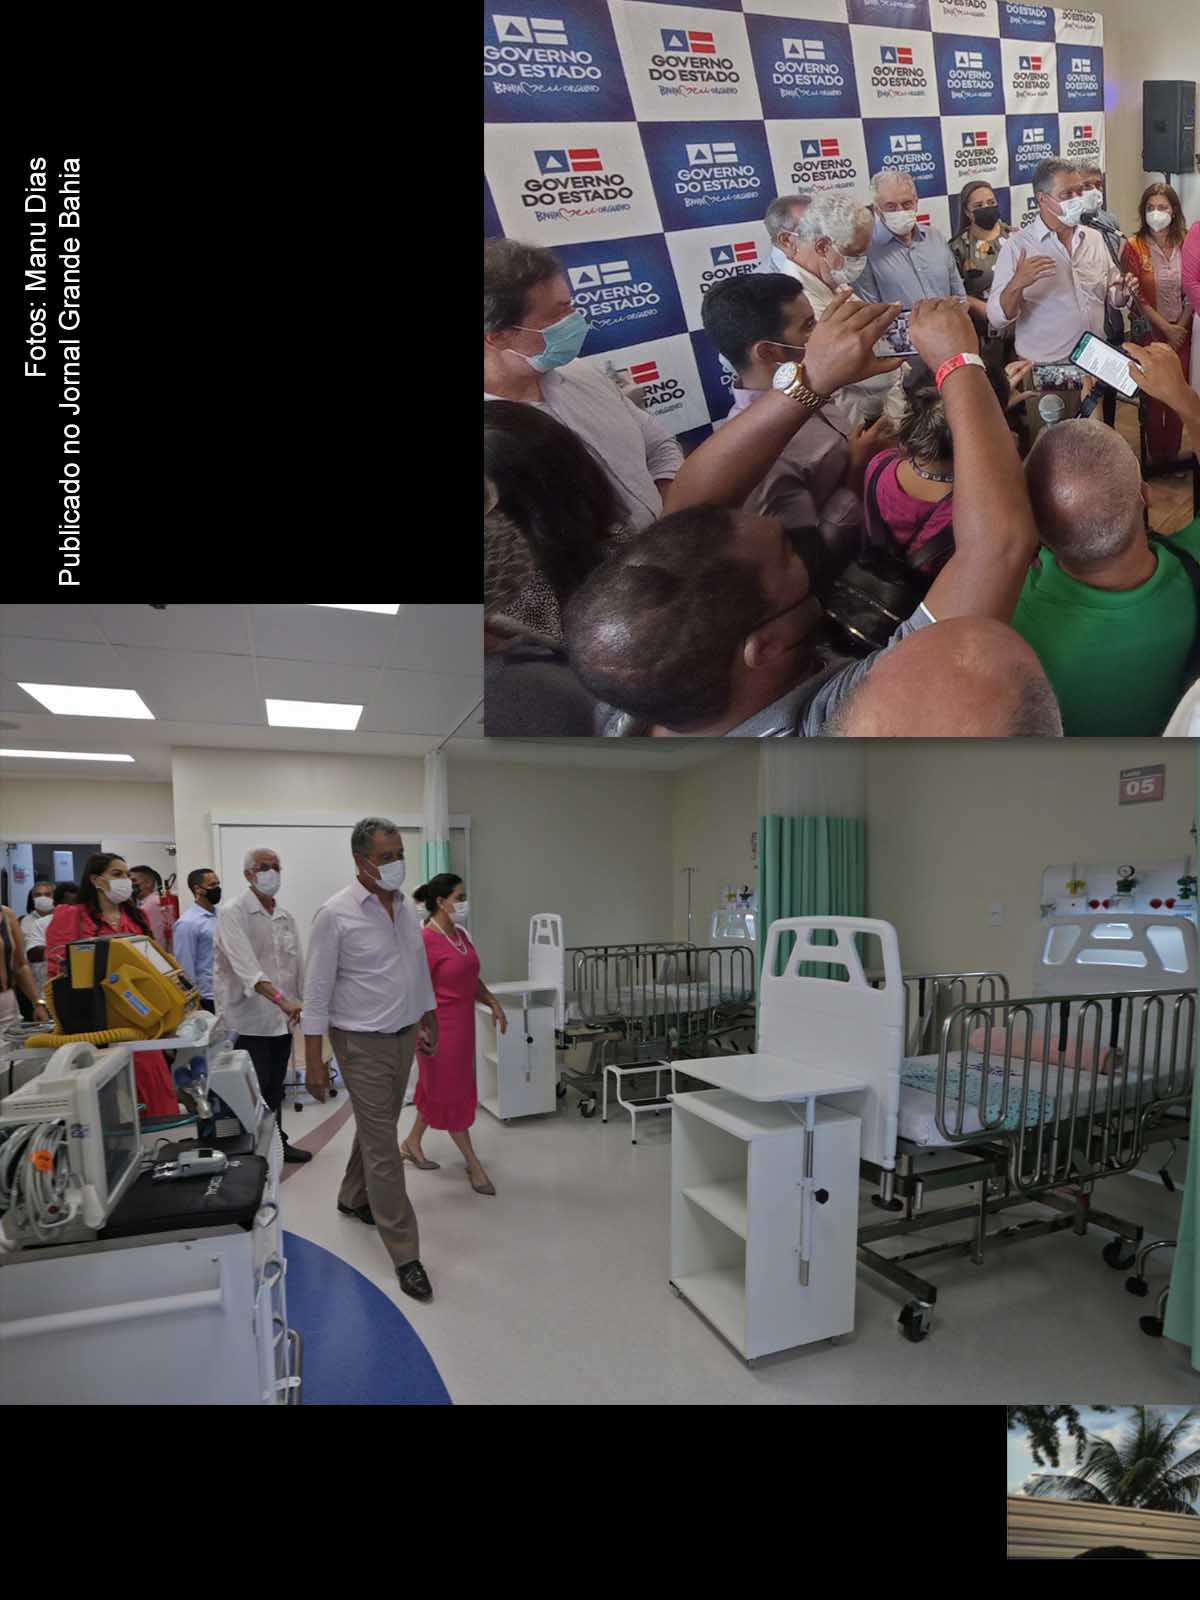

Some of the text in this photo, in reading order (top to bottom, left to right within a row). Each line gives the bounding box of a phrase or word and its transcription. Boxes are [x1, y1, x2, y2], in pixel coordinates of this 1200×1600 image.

[484, 45, 592, 64] GOVERNO
[651, 54, 734, 70] GOVERNO
[774, 61, 840, 75] GOVERNO
[519, 63, 602, 79] ESTADO
[648, 68, 740, 83] DO ESTADO
[873, 66, 924, 77] GOVERNO
[948, 69, 992, 80] GOVERNO
[1014, 72, 1048, 81] GOVERNO
[1066, 73, 1097, 82] GOVERNO
[772, 73, 844, 86] DO ESTADO
[871, 77, 927, 88] DO ESTADO
[946, 79, 994, 89] DO ESTADO
[1012, 81, 1050, 89] DO ESTADO
[1065, 82, 1098, 90] DO ESTADO
[955, 147, 996, 158] GOVERNO
[1017, 143, 1051, 153] GOVERNO
[883, 152, 933, 165] GOVERNO
[954, 156, 998, 168] DO ESTADO
[1015, 151, 1054, 162] DO ESTADO
[793, 158, 852, 172] GOVERNO
[677, 165, 754, 181] GOVERNO
[791, 169, 857, 183] DO ESTADO
[524, 174, 625, 192] GOVERNO
[675, 177, 761, 194] DO ESTADO
[521, 187, 633, 207] DO ESTADO
[570, 282, 652, 306] OVERNO
[589, 293, 660, 316] ESTADO
[1126, 779, 1154, 796] 05
